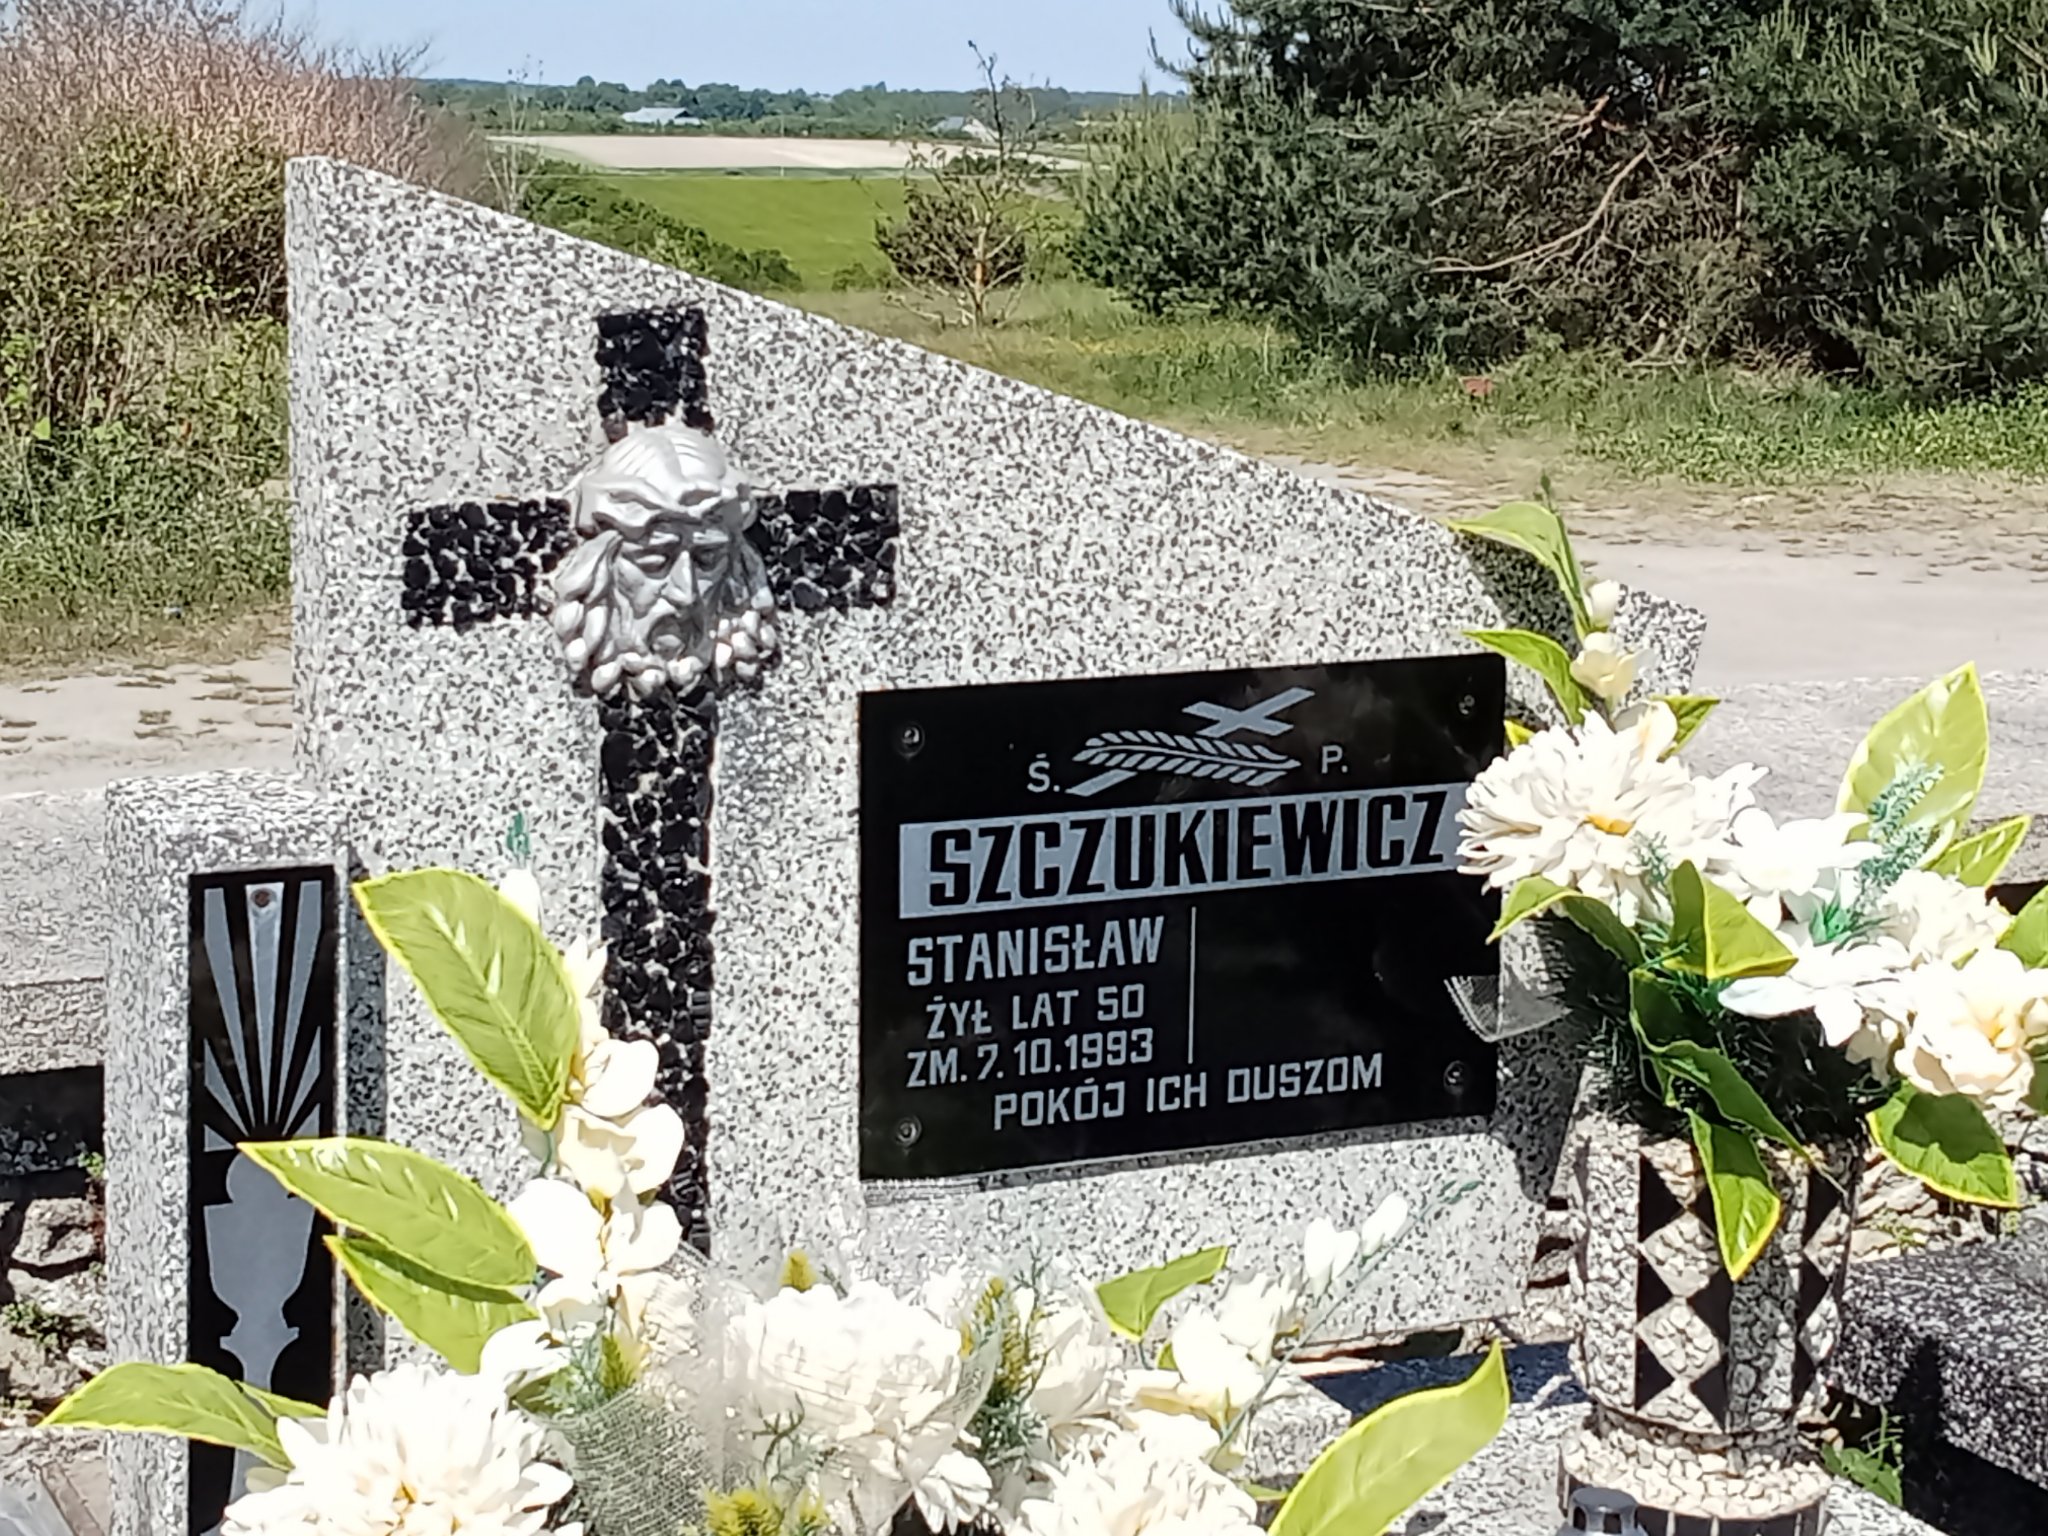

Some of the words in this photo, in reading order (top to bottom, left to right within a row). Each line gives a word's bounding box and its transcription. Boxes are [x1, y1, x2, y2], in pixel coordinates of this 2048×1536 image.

[1321, 745, 1349, 774] P.
[928, 790, 1449, 908] SZCZUKIEWICZ
[907, 916, 1164, 986] STANISŁAW
[926, 996, 991, 1040] ŻYŁ
[1012, 991, 1079, 1029] LAT
[1097, 983, 1144, 1021] 50
[994, 1077, 1126, 1130] POKÓJ
[1146, 1072, 1206, 1112] ICH
[1227, 1053, 1383, 1103] DUSZOM
